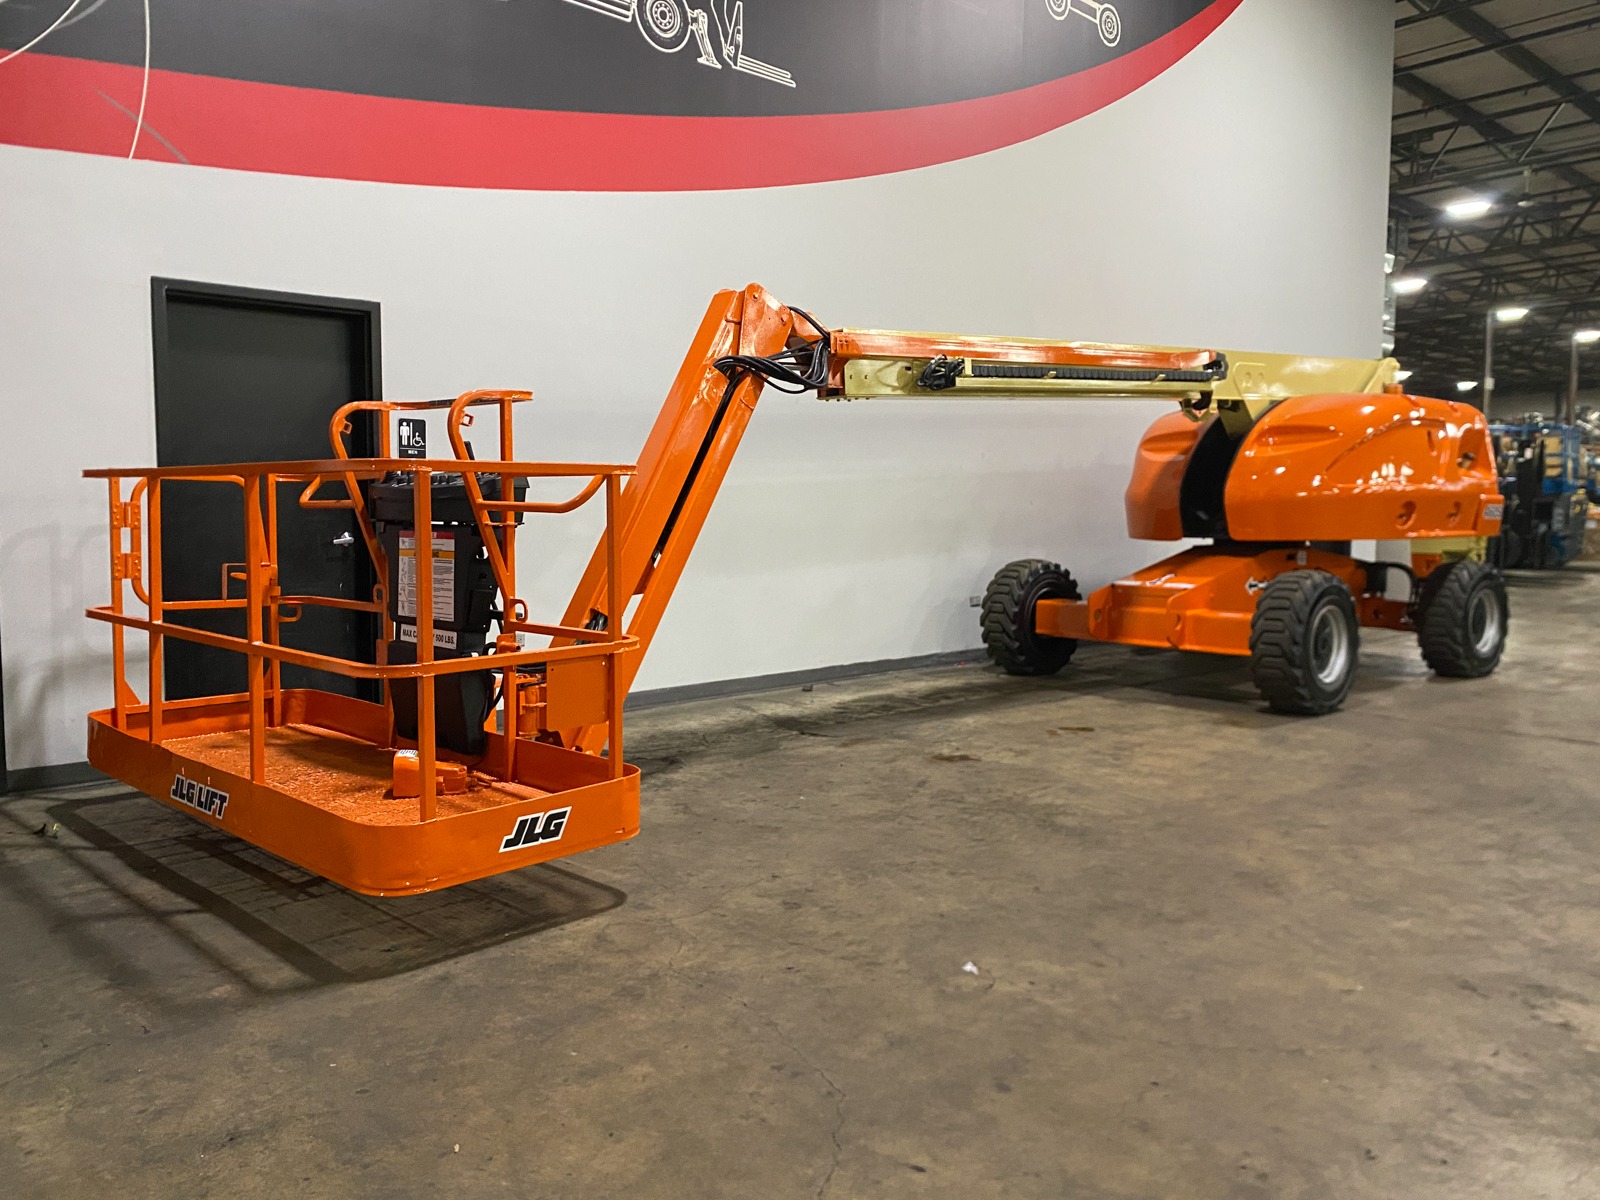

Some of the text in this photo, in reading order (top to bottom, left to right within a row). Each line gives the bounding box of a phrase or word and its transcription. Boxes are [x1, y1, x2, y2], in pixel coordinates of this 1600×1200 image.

[402, 628, 412, 638] MAX
[435, 633, 444, 643] 500
[445, 635, 455, 645] LBS.
[171, 775, 228, 817] JLG LIFT
[502, 809, 569, 849] JLG
